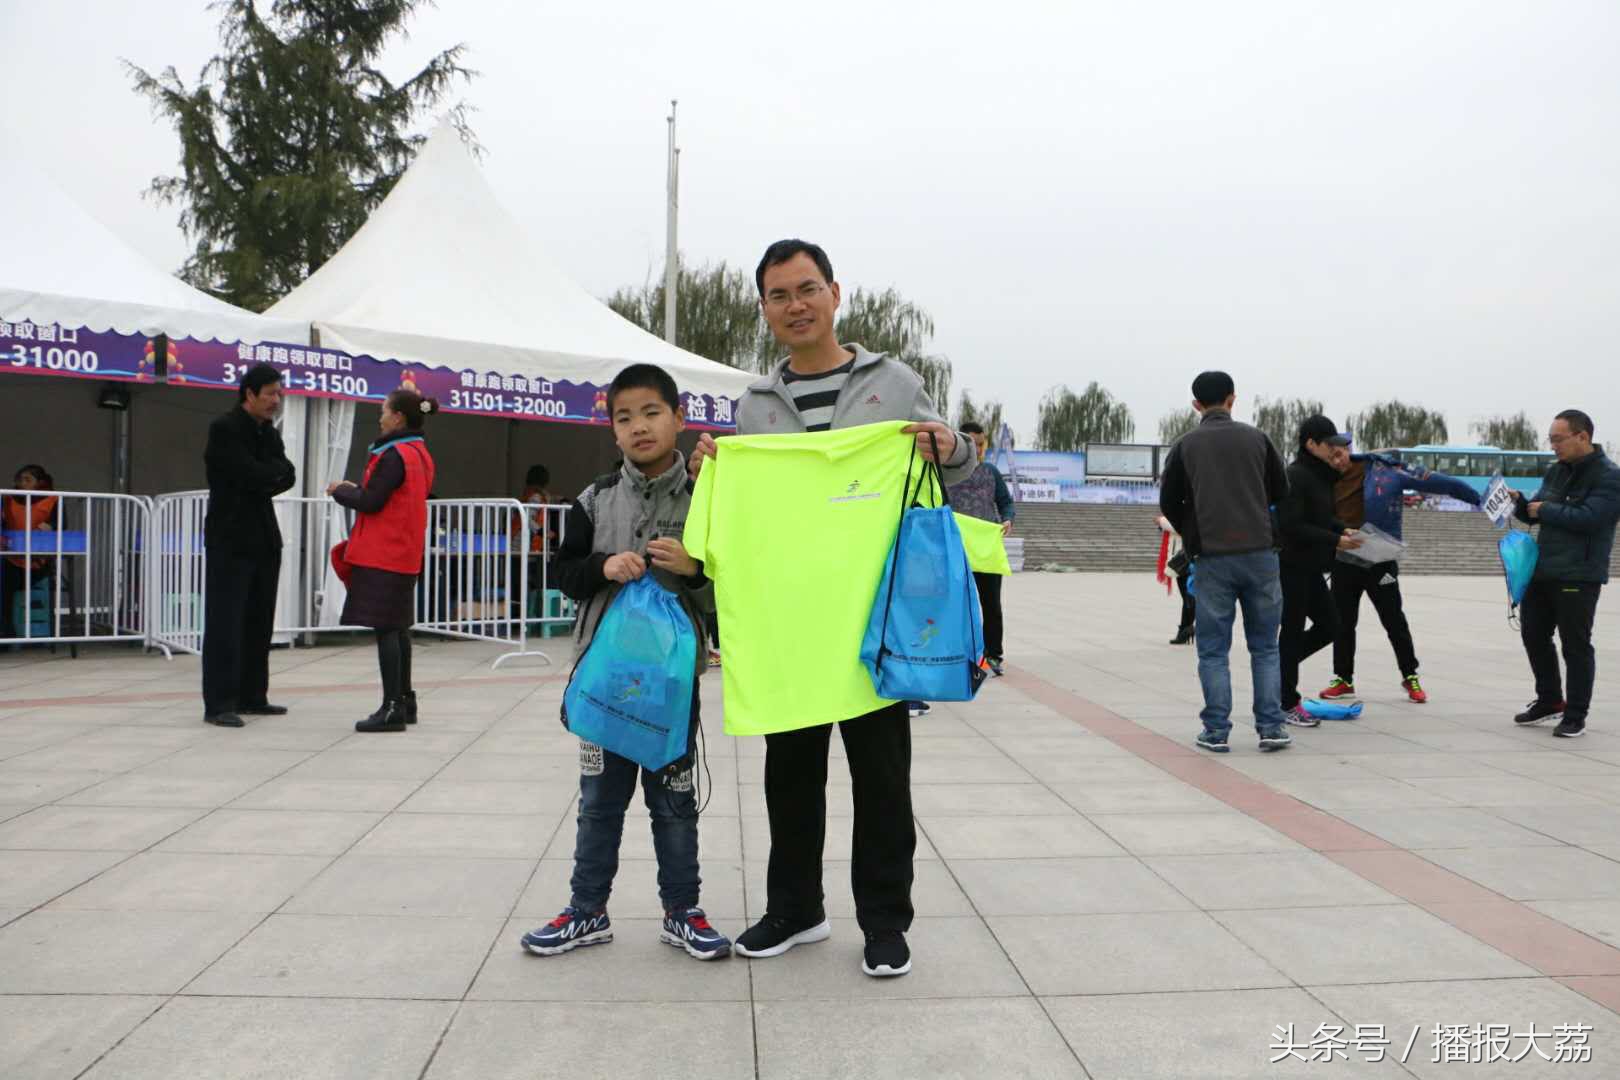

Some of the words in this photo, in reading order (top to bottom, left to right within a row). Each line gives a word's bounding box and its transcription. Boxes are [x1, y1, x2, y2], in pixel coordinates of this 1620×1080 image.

[238, 343, 352, 371] 健康跑领取窗口
[223, 363, 368, 396] 311-31500
[461, 371, 553, 395] 健康跑领取窗口
[450, 389, 566, 417] 31501-32000
